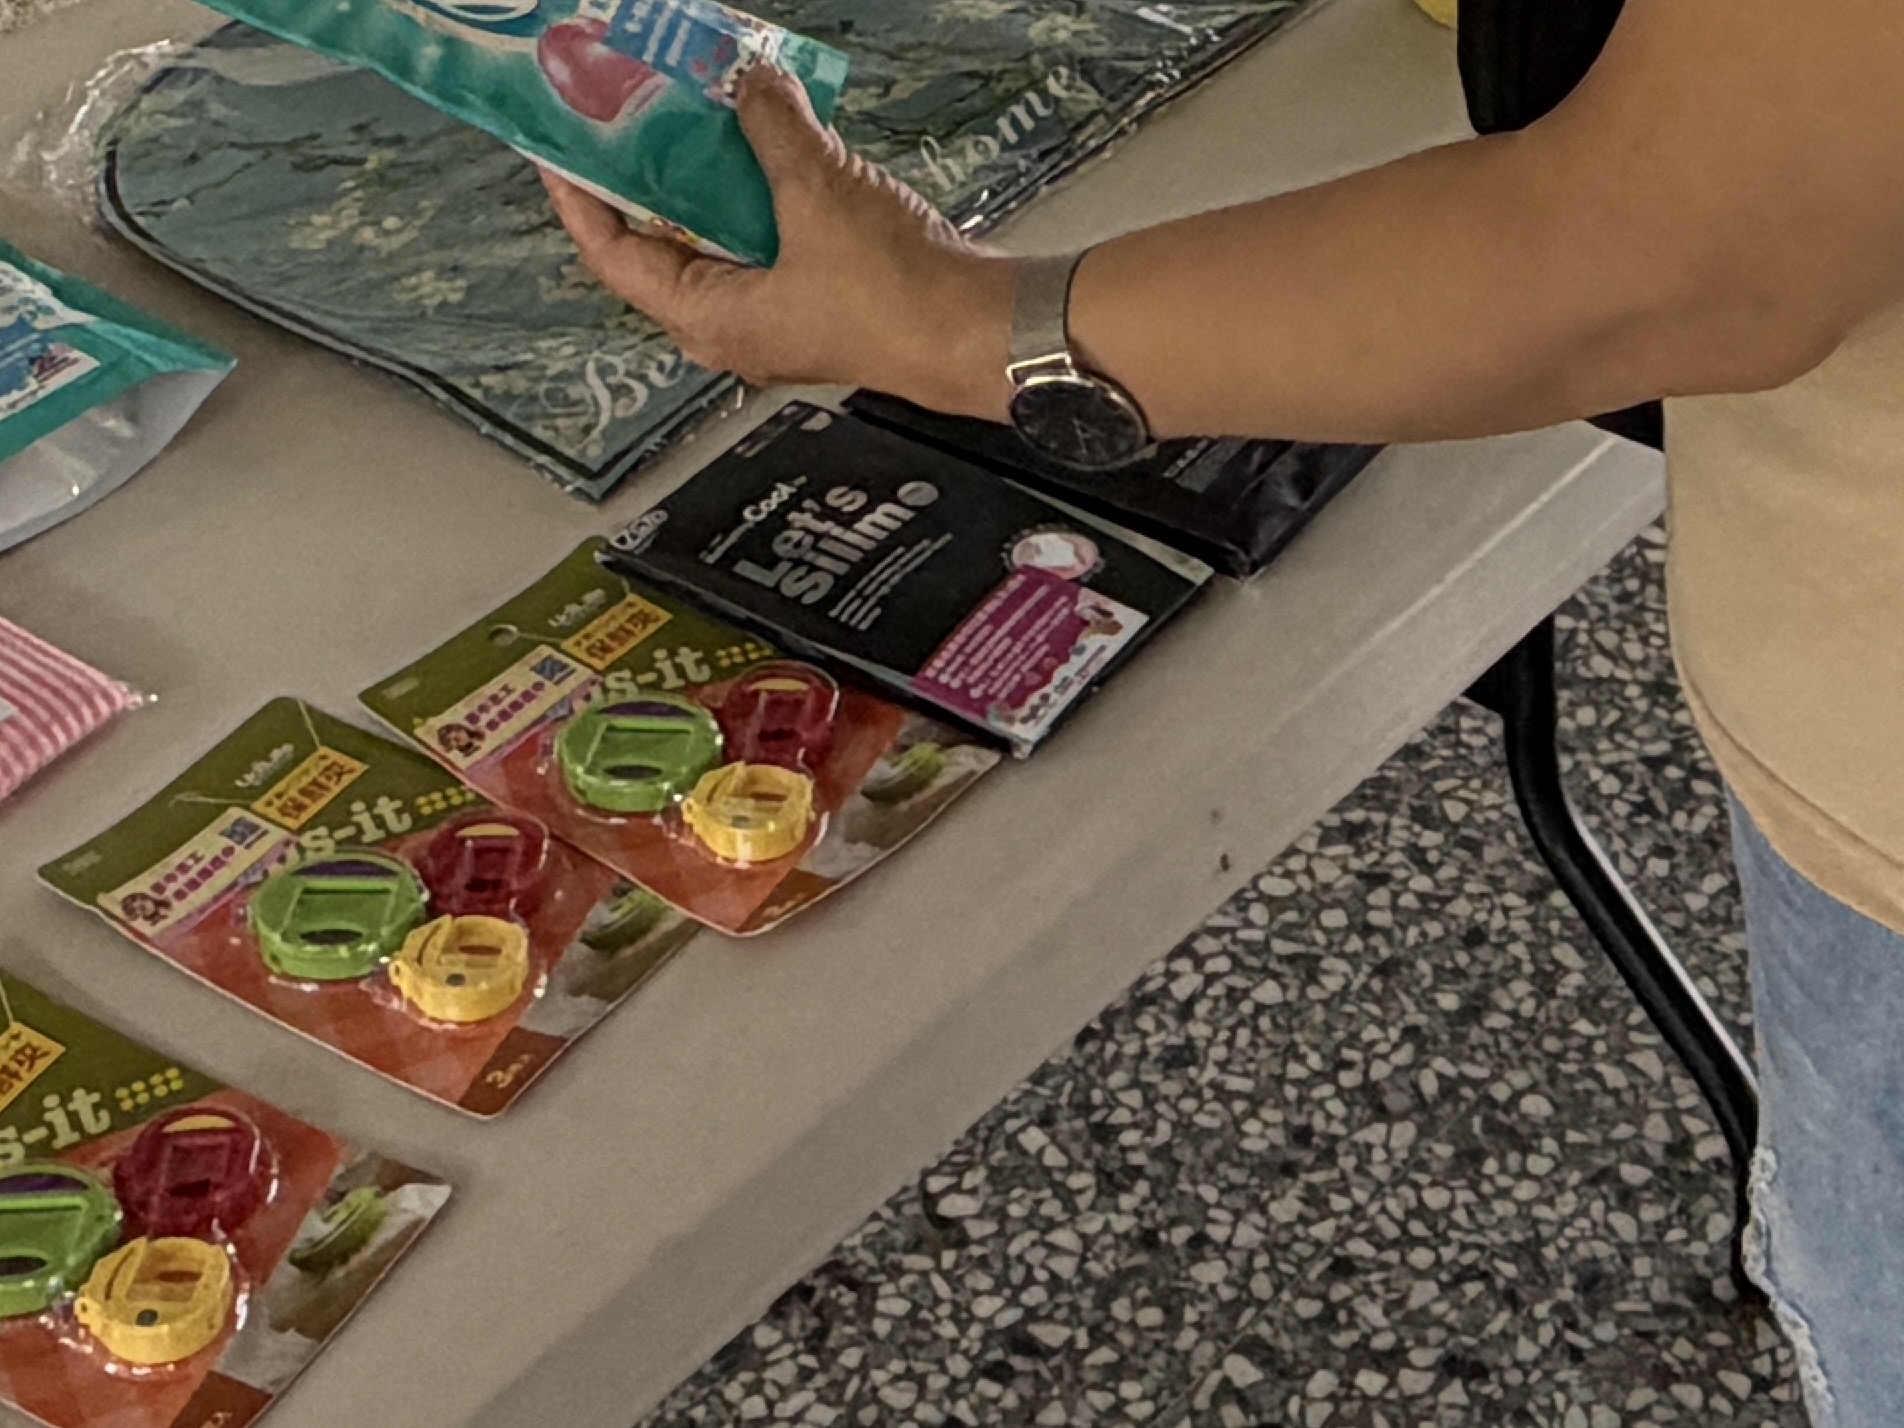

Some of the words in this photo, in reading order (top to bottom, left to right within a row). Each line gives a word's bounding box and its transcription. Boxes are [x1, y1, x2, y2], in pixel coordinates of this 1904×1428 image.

[733, 480, 869, 590] Let's
[599, 640, 714, 710] s-it
[295, 791, 413, 866] s-it
